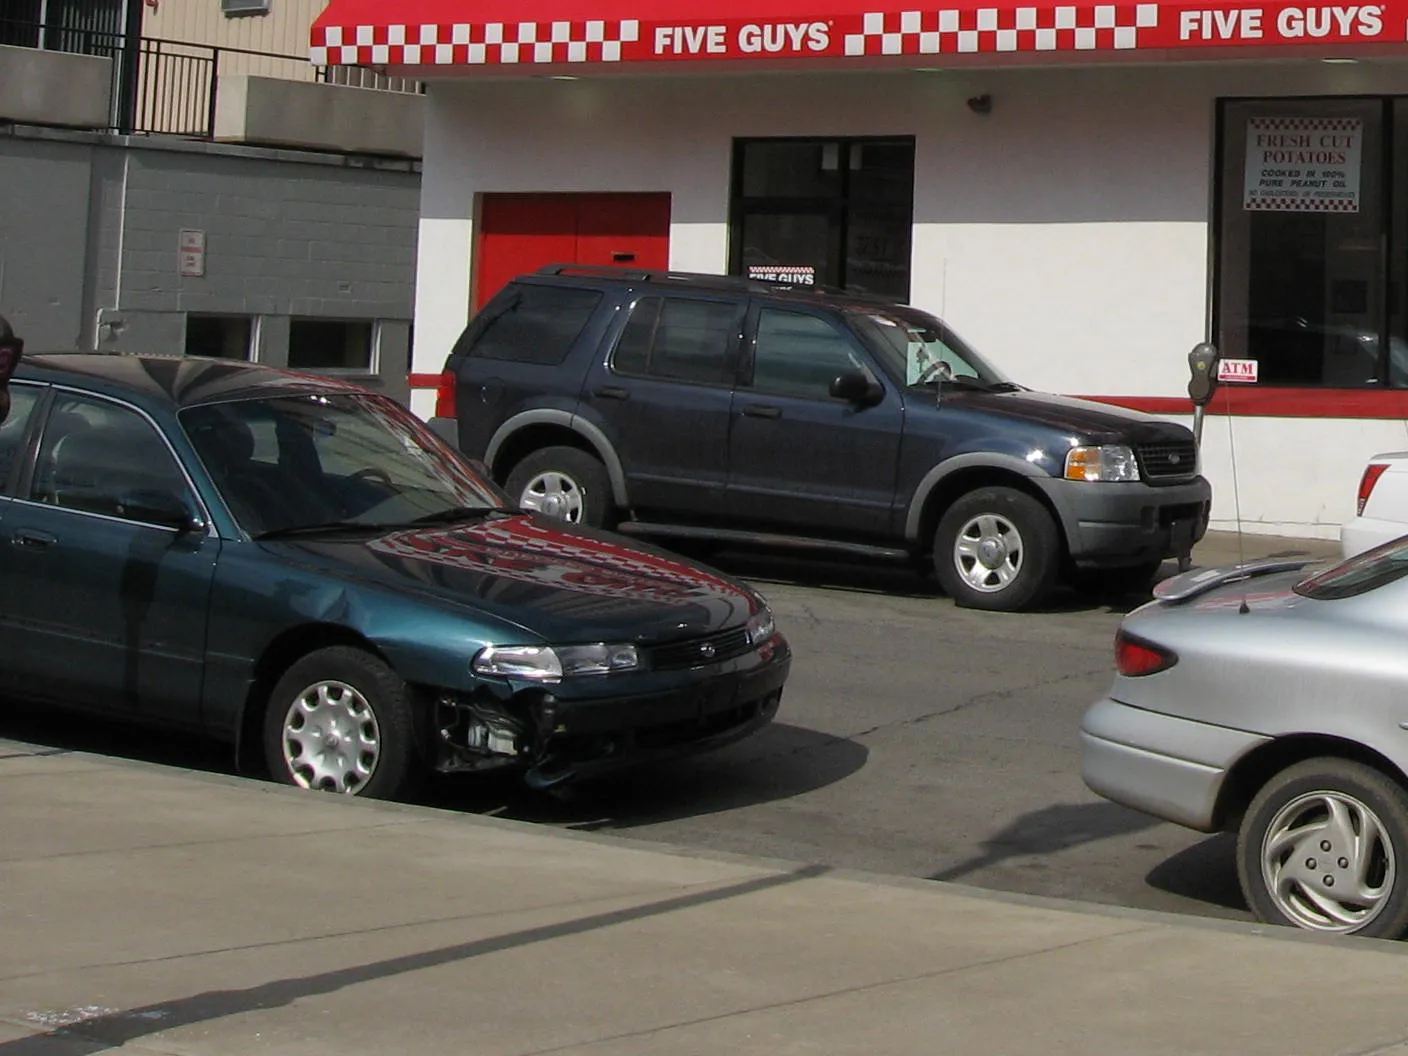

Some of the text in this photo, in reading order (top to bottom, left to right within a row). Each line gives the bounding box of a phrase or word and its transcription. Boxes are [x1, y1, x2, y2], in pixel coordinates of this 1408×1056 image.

[1180, 5, 1383, 40] FIVE GUYS
[655, 22, 830, 55] FIVE GUYS
[1257, 134, 1354, 148] FRESH CUT
[1263, 151, 1346, 164] POTATOES
[1261, 169, 1345, 178] COOKED IN 100%
[1259, 179, 1283, 187] PURE
[1291, 180, 1328, 188] PEANUT
[1222, 362, 1253, 375] ATM
